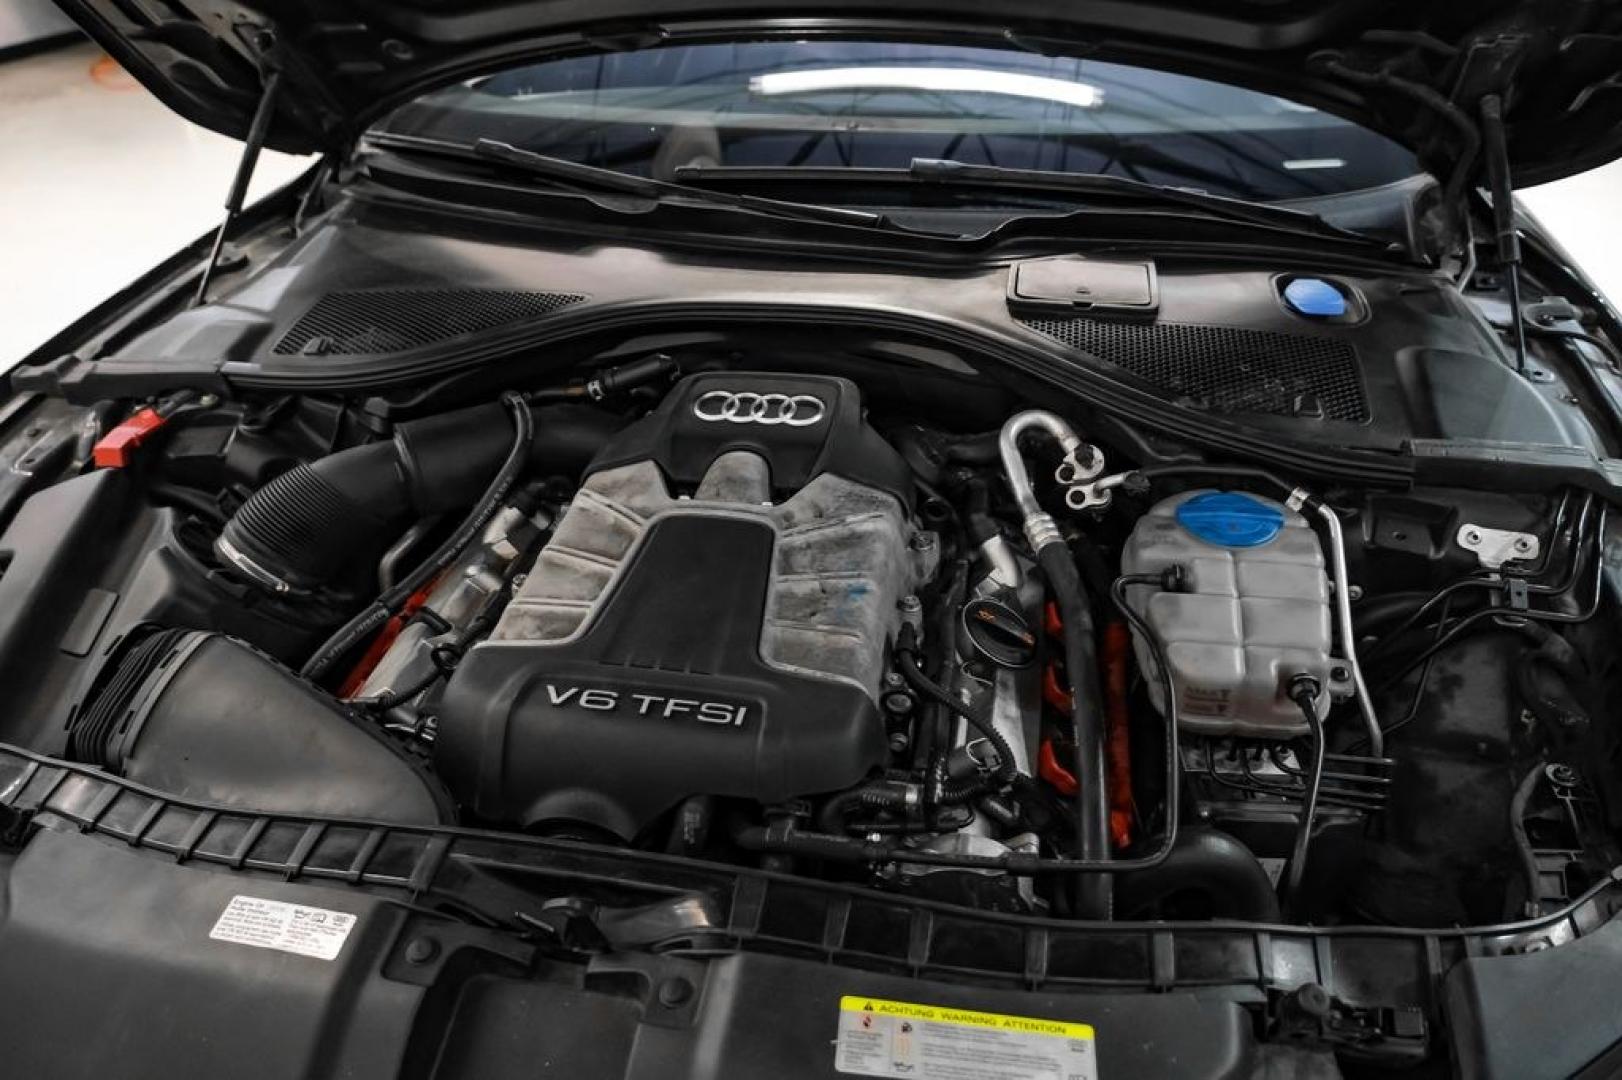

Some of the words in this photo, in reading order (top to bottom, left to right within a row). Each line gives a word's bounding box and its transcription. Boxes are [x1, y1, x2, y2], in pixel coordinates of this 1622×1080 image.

[546, 684, 619, 710] V6
[632, 694, 747, 726] TFSI
[878, 1004, 935, 1019] ACHTUNG
[940, 1012, 997, 1027] WARNING
[1003, 1020, 1067, 1035] ATTENTION
